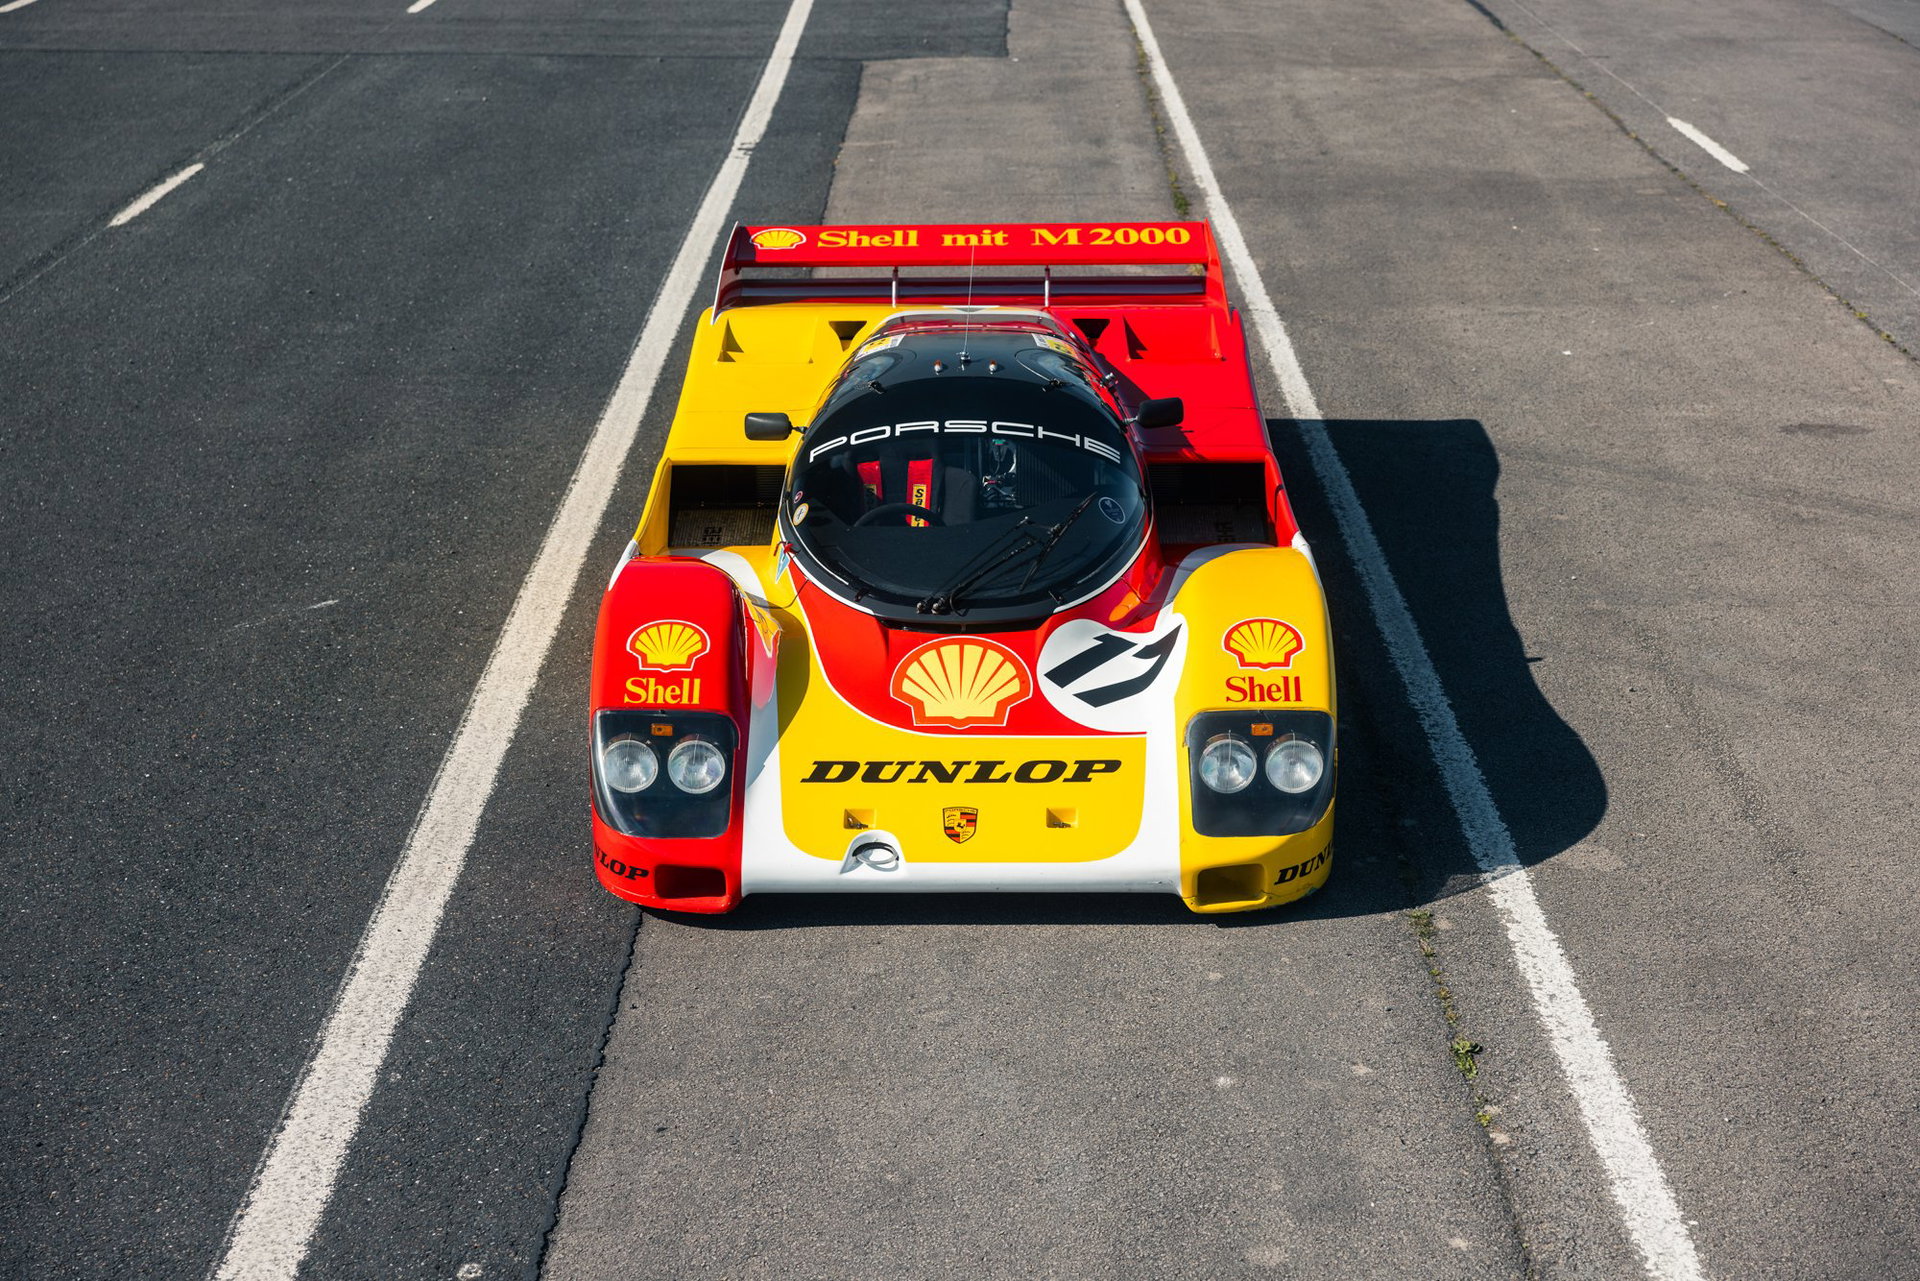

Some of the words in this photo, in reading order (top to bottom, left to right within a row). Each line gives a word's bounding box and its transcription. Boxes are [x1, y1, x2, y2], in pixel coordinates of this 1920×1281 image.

[817, 229, 918, 248] Shell
[942, 229, 1009, 247] mit
[809, 419, 1121, 464] PORSCHE
[624, 677, 701, 705] Shell
[1225, 675, 1302, 703] Shell
[800, 759, 1122, 784] DUNLOP
